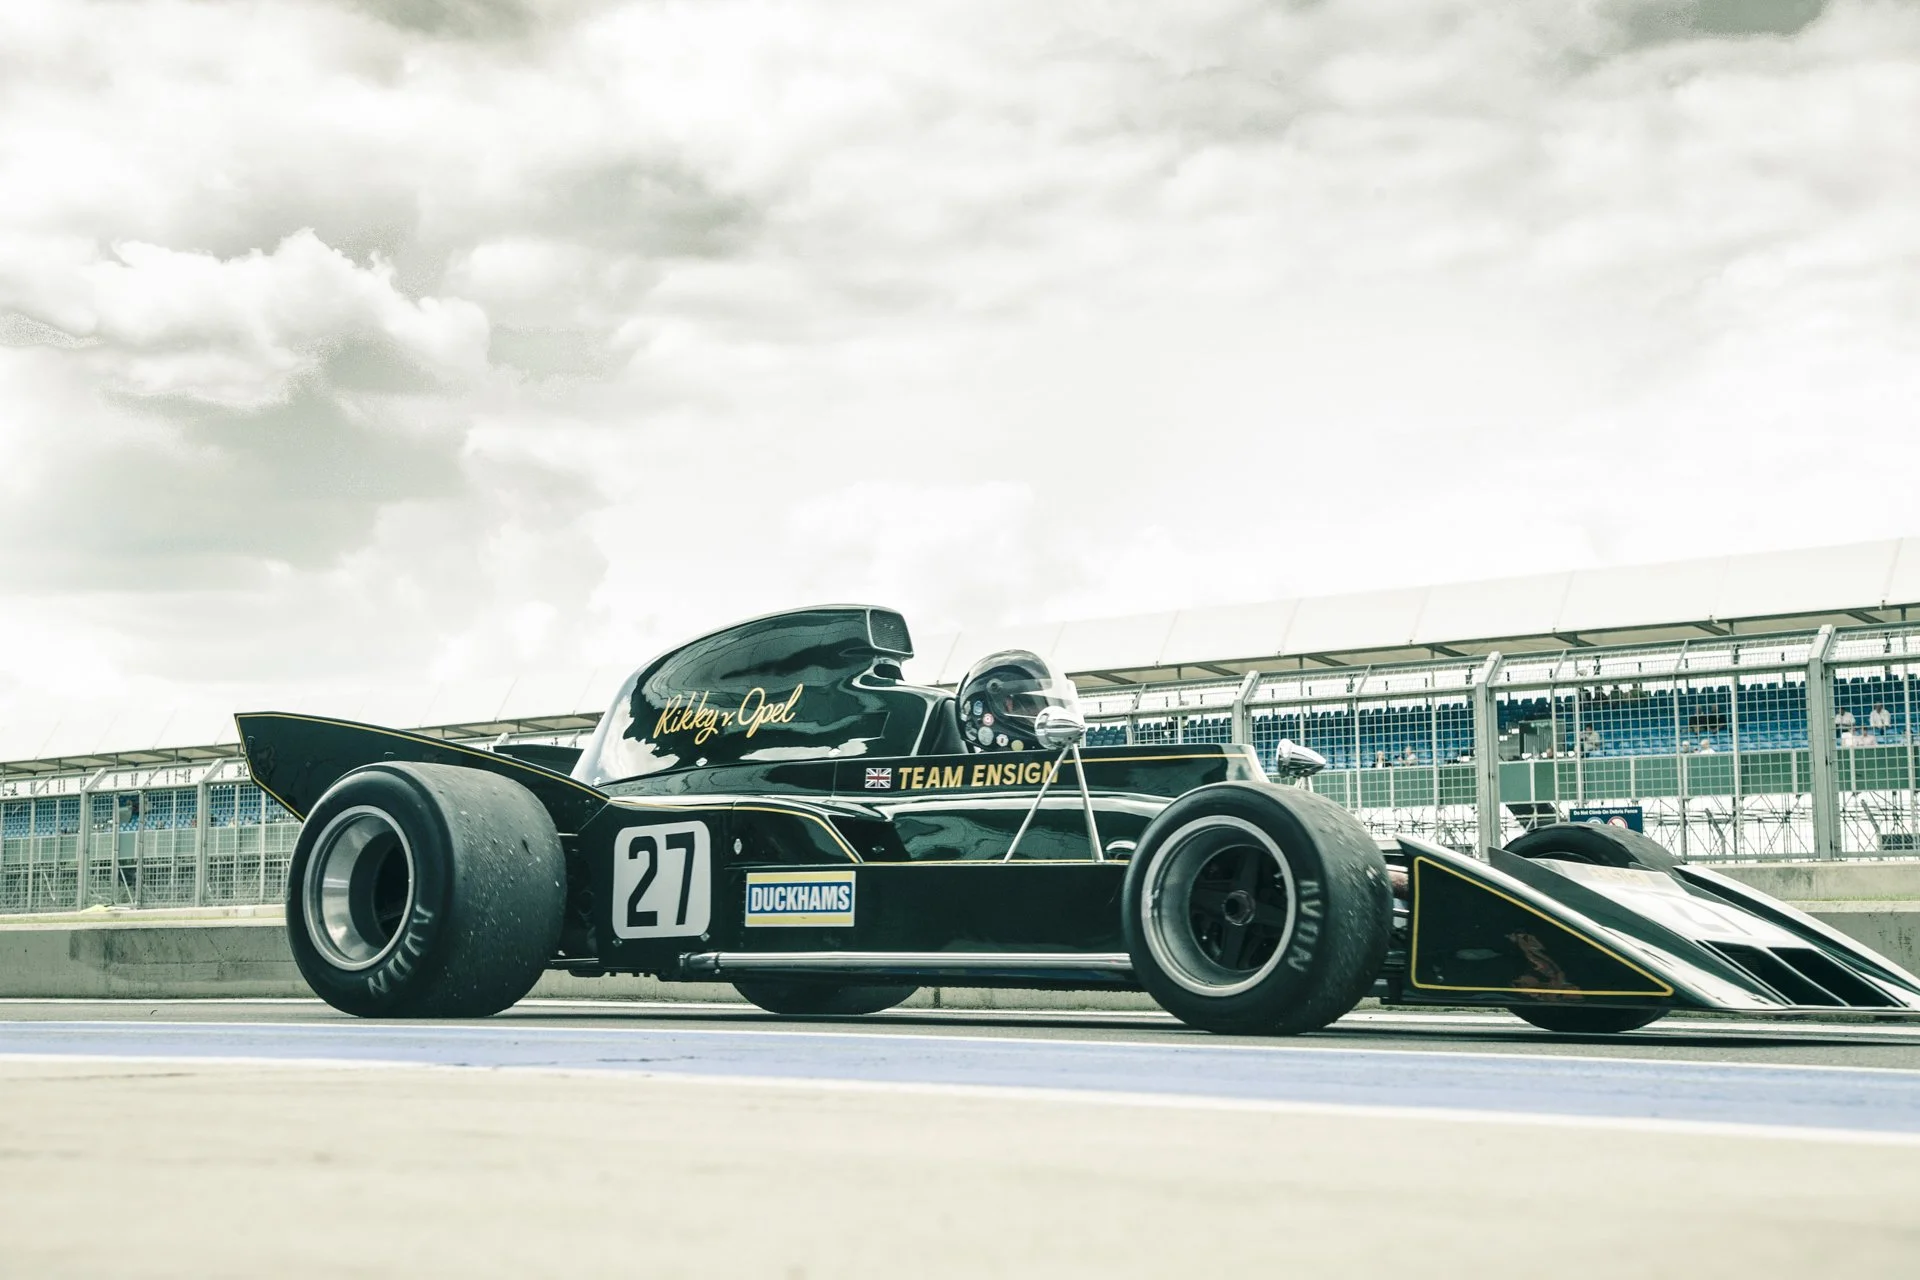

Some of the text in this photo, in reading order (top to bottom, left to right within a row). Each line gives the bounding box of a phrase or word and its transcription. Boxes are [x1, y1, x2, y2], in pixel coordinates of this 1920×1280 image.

[653, 690, 718, 745] Rikky
[737, 683, 804, 738] Opel
[899, 760, 1059, 789] TEAM ENSIGN
[626, 831, 696, 928] 27
[751, 885, 850, 911] DUCKHAMS
